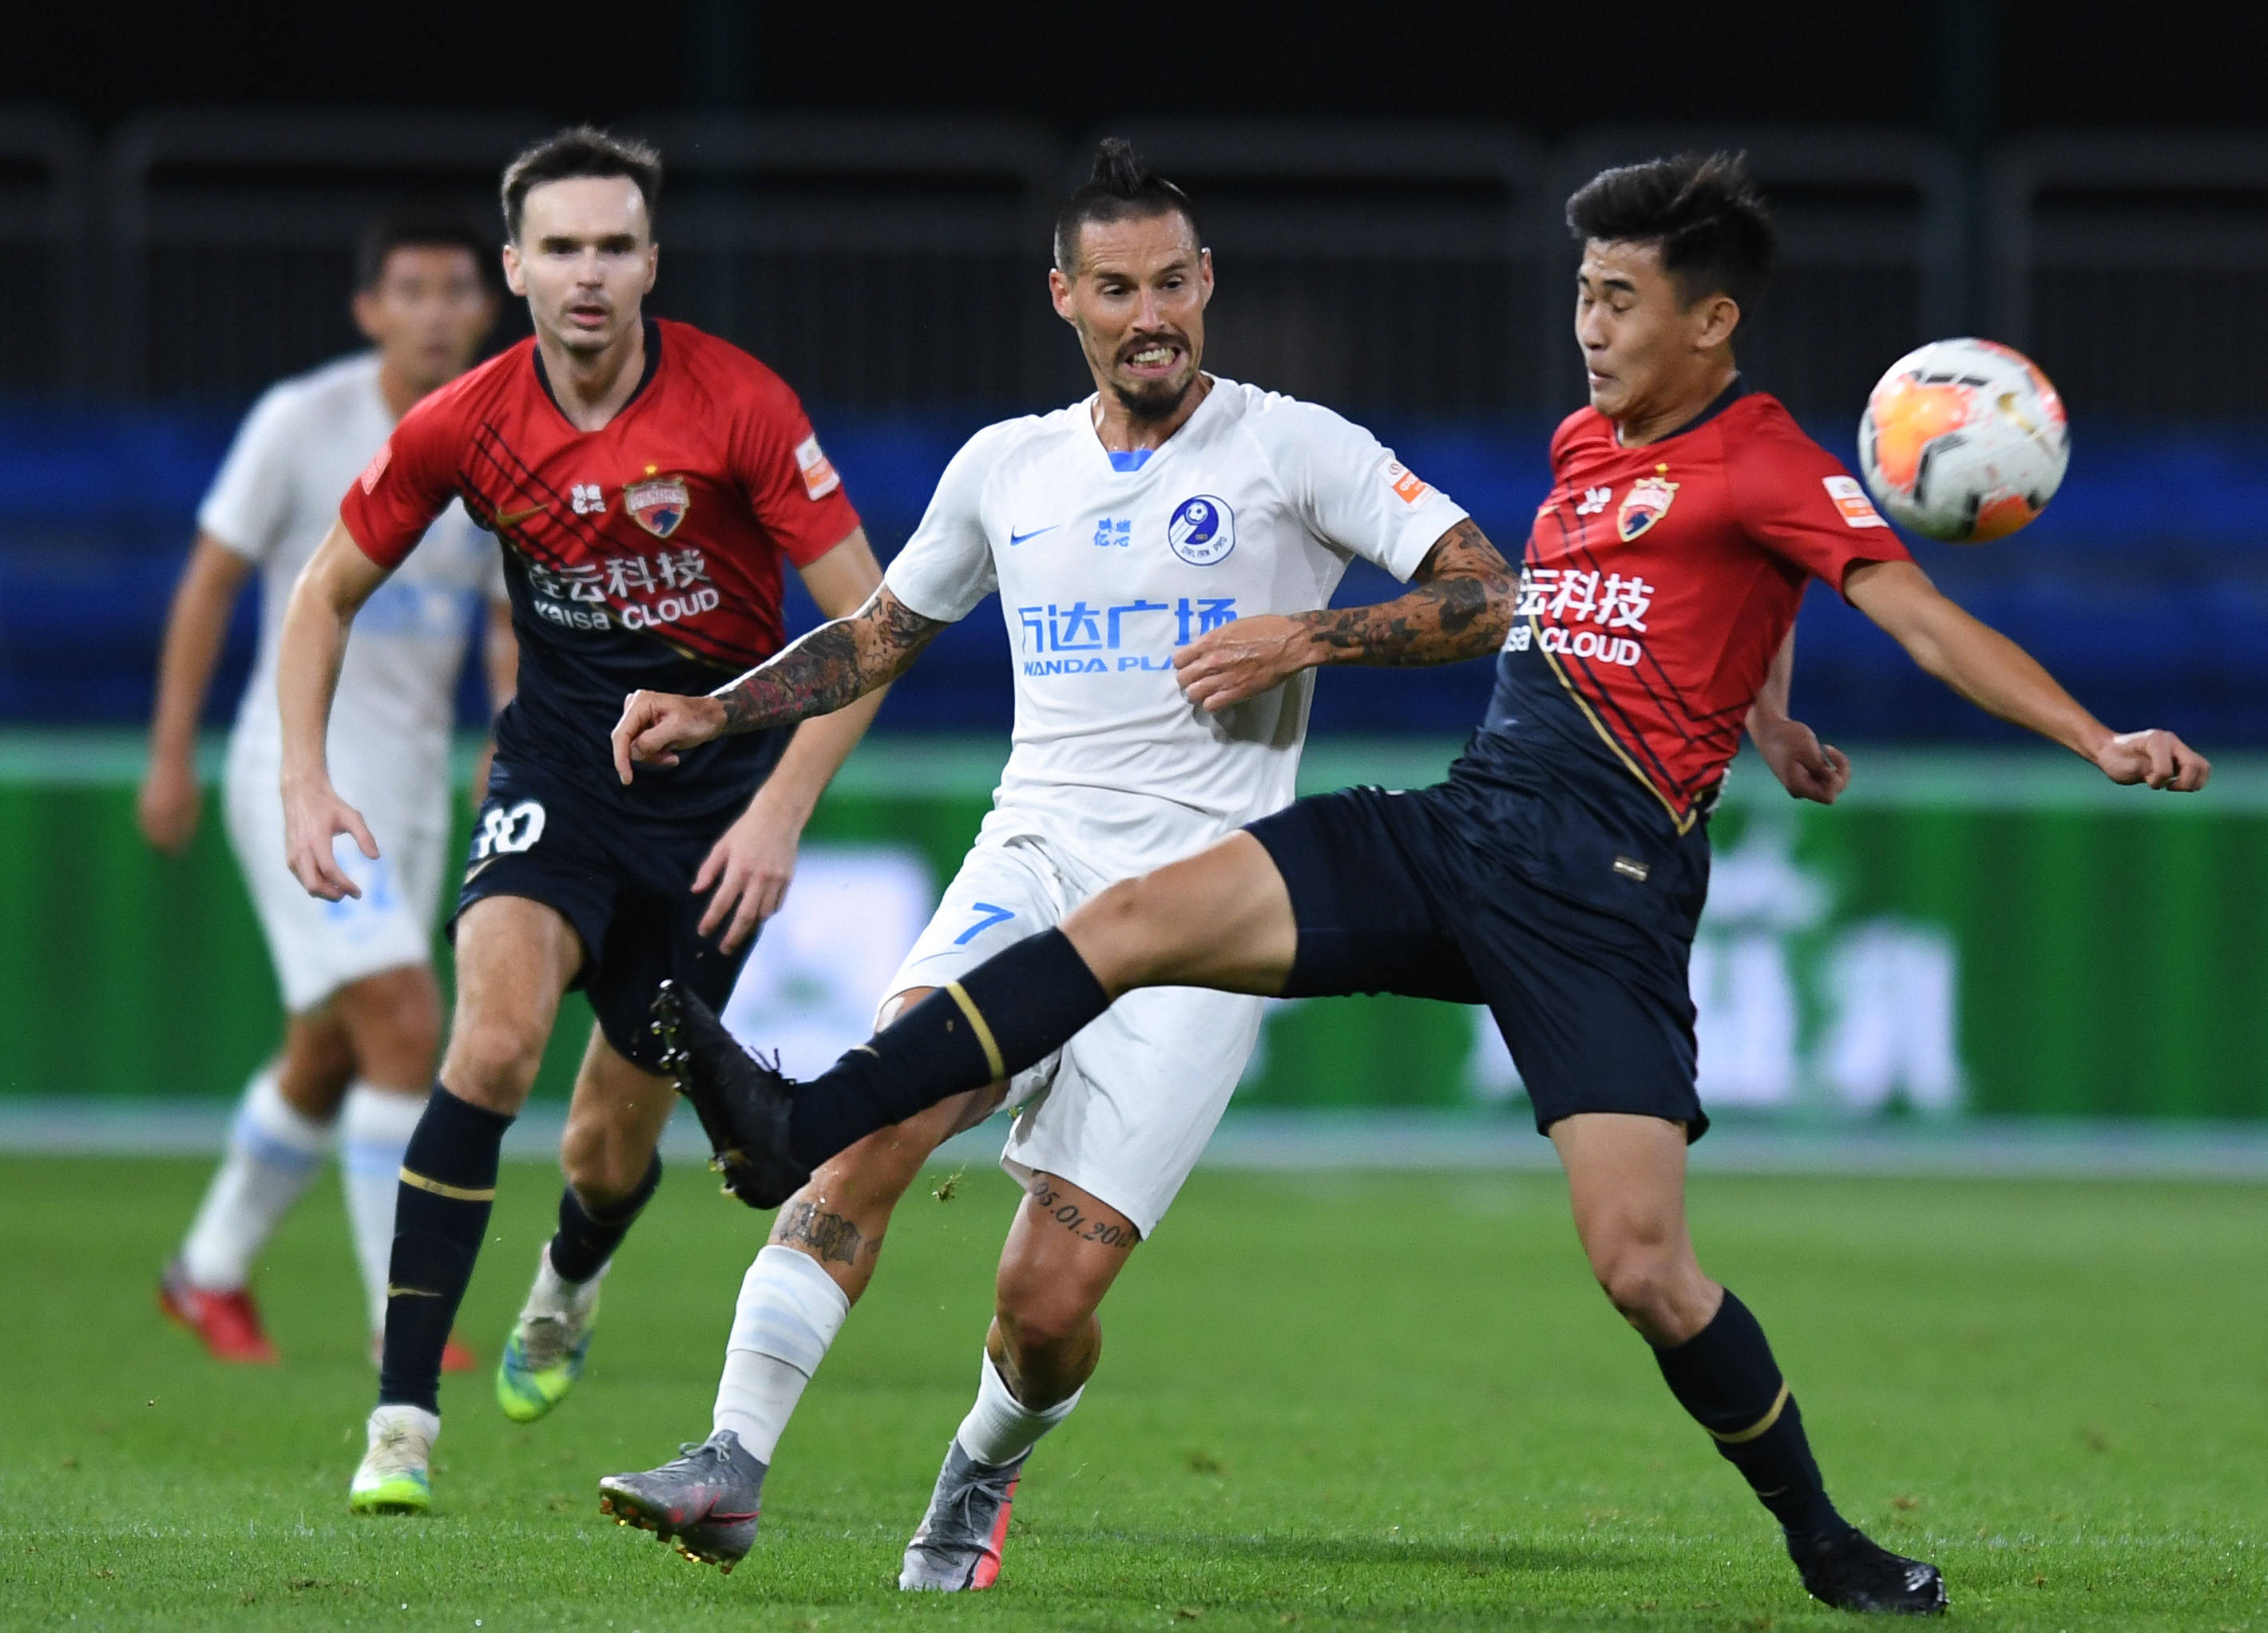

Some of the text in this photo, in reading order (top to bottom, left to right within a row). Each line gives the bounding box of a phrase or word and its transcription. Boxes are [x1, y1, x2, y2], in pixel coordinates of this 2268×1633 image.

[621, 588, 720, 630] CLOUD
[1515, 563, 1655, 632] 云科技
[1023, 657, 1108, 676] WANDA
[1540, 627, 1641, 666] CLOUD
[954, 902, 1015, 945] 7
